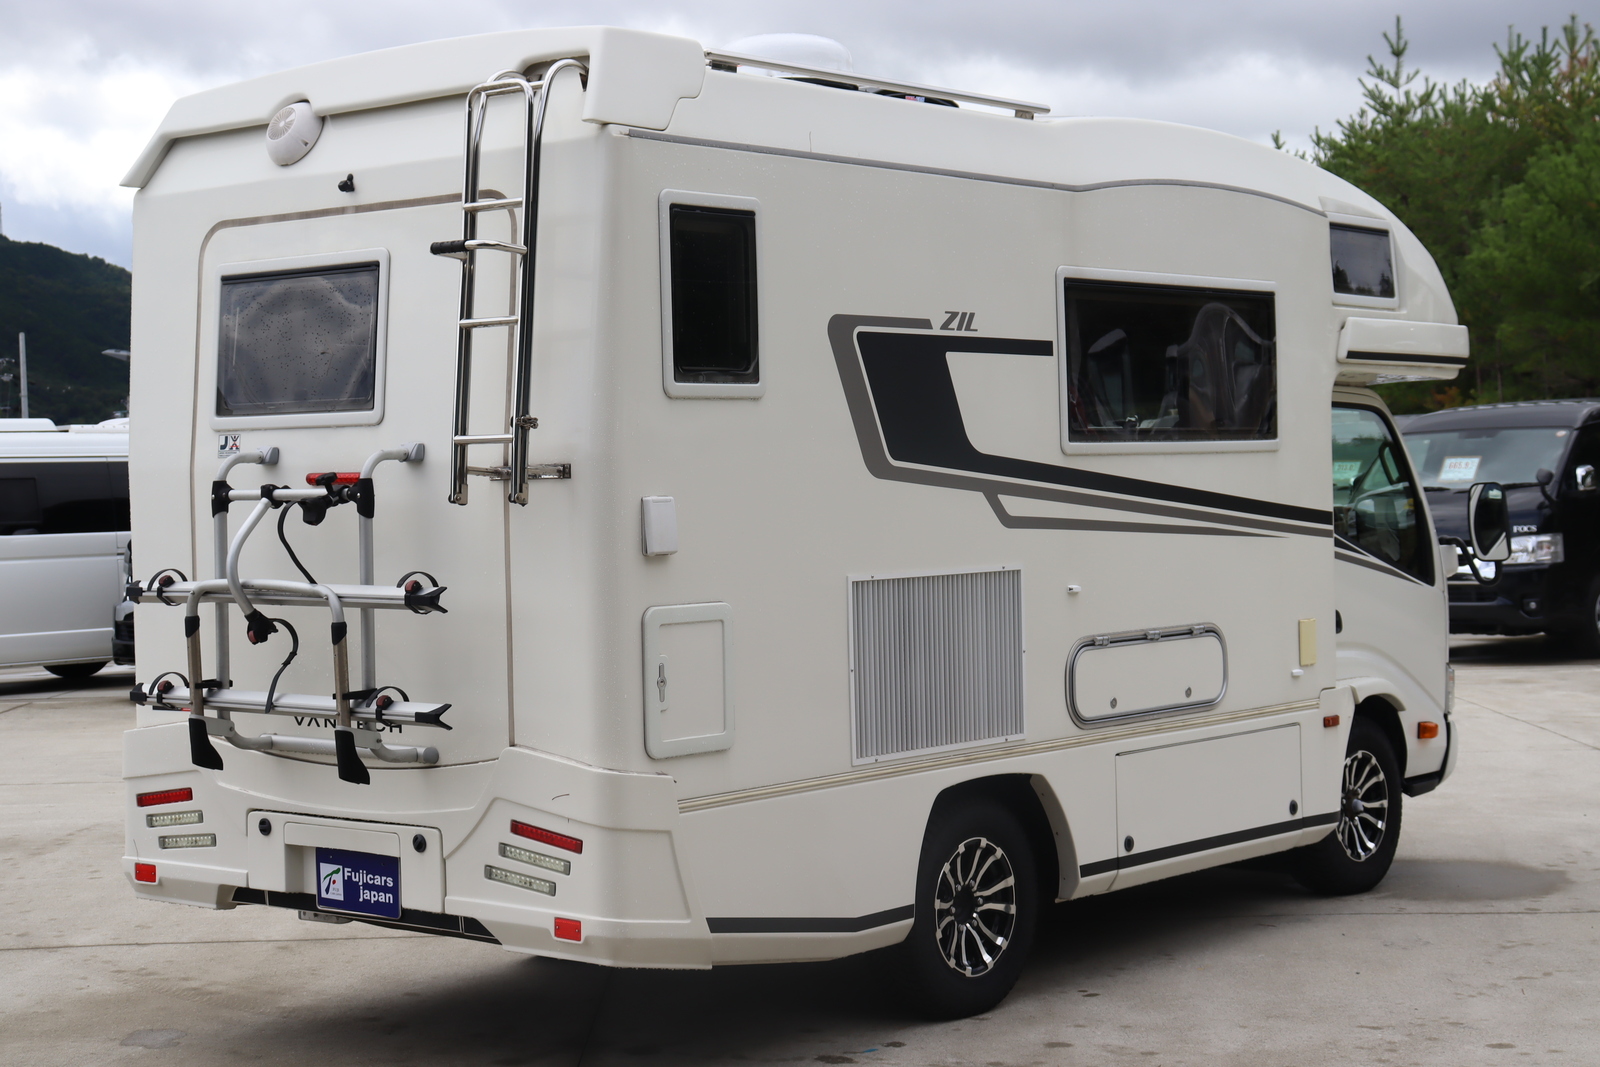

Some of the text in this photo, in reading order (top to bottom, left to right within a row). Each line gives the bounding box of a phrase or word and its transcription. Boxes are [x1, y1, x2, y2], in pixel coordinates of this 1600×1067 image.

[939, 310, 978, 331] ZIL
[344, 867, 393, 887] Fujicars
[358, 886, 393, 904] japan
